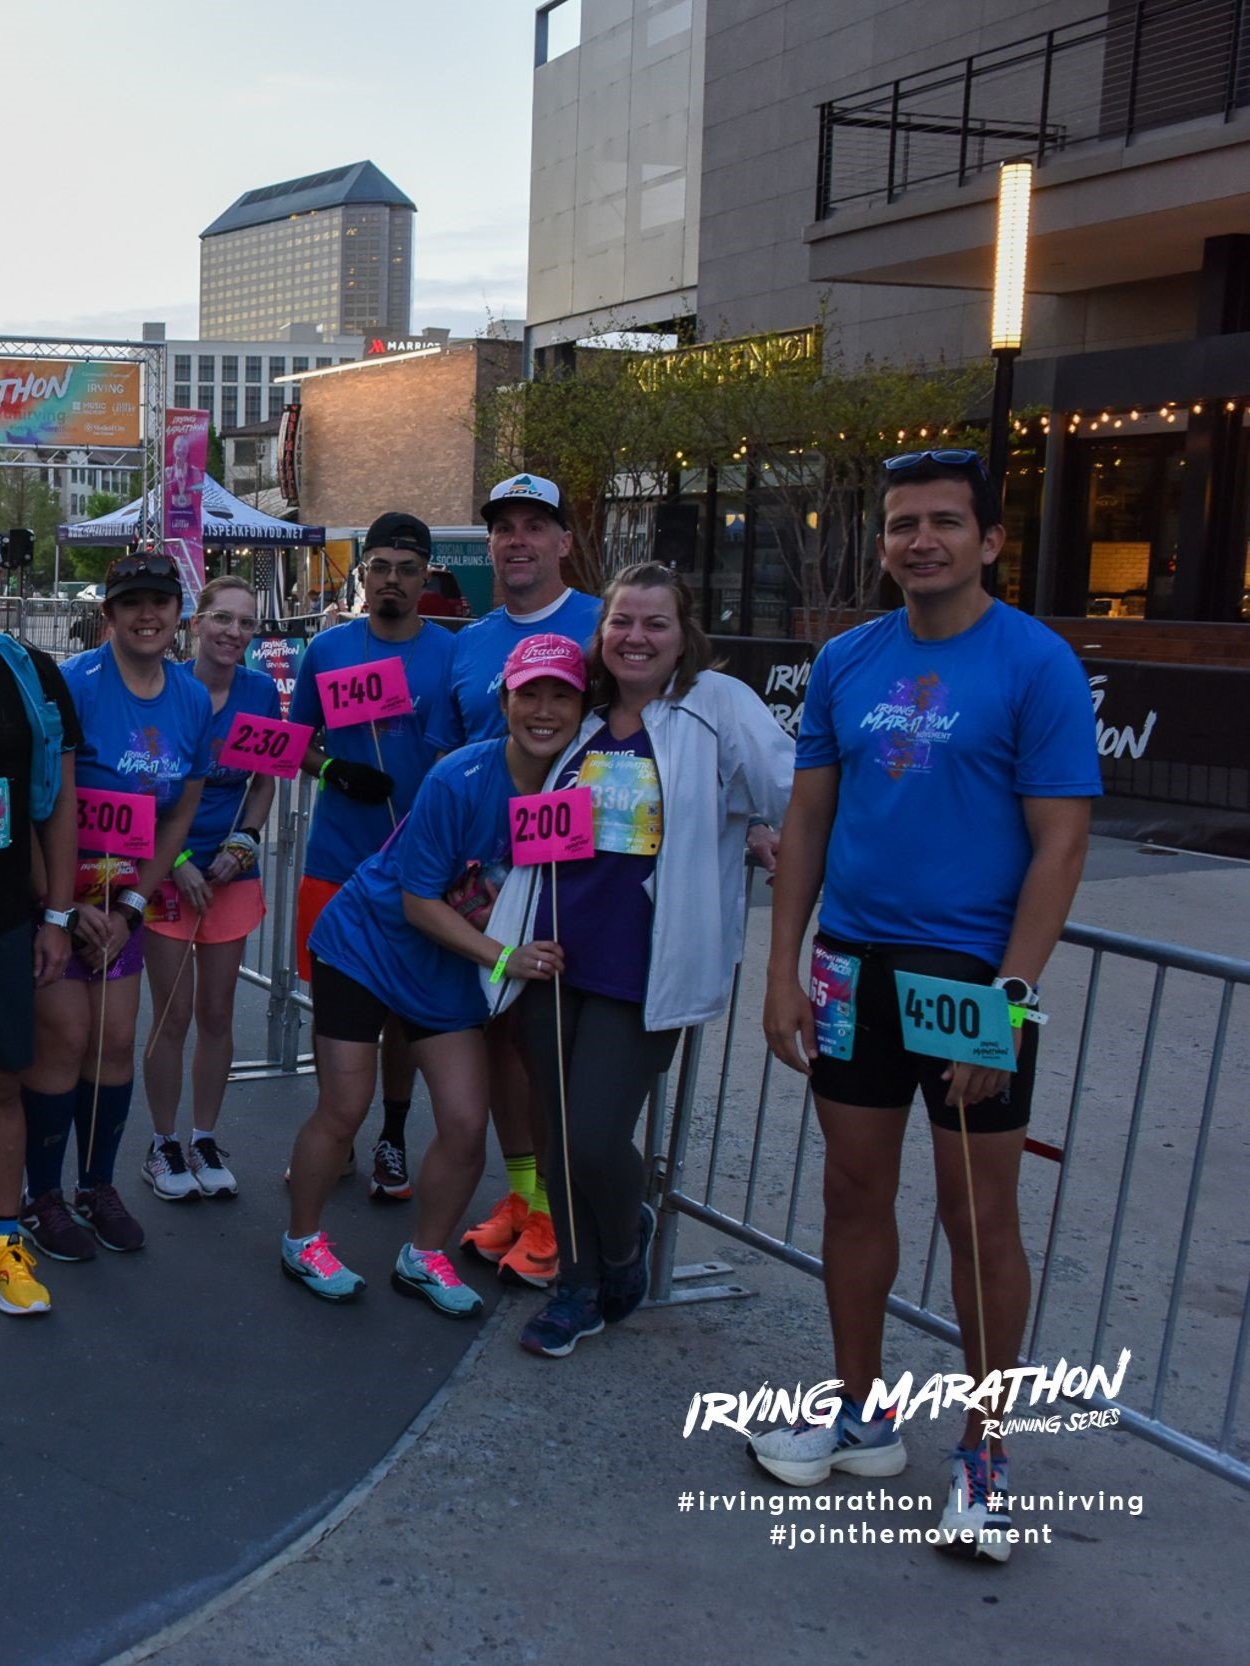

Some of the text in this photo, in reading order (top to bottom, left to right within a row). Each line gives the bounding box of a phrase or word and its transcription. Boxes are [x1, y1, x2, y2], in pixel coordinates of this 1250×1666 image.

[252, 644, 300, 661] MARATHON
[261, 639, 287, 650] IRVING
[521, 643, 571, 660] Tractor
[327, 672, 383, 710] 1:40
[874, 703, 916, 716] IRVING
[230, 724, 290, 758] 2:30
[78, 799, 133, 835] 3:00
[515, 802, 571, 842] 2:00
[905, 988, 981, 1039] 4:00
